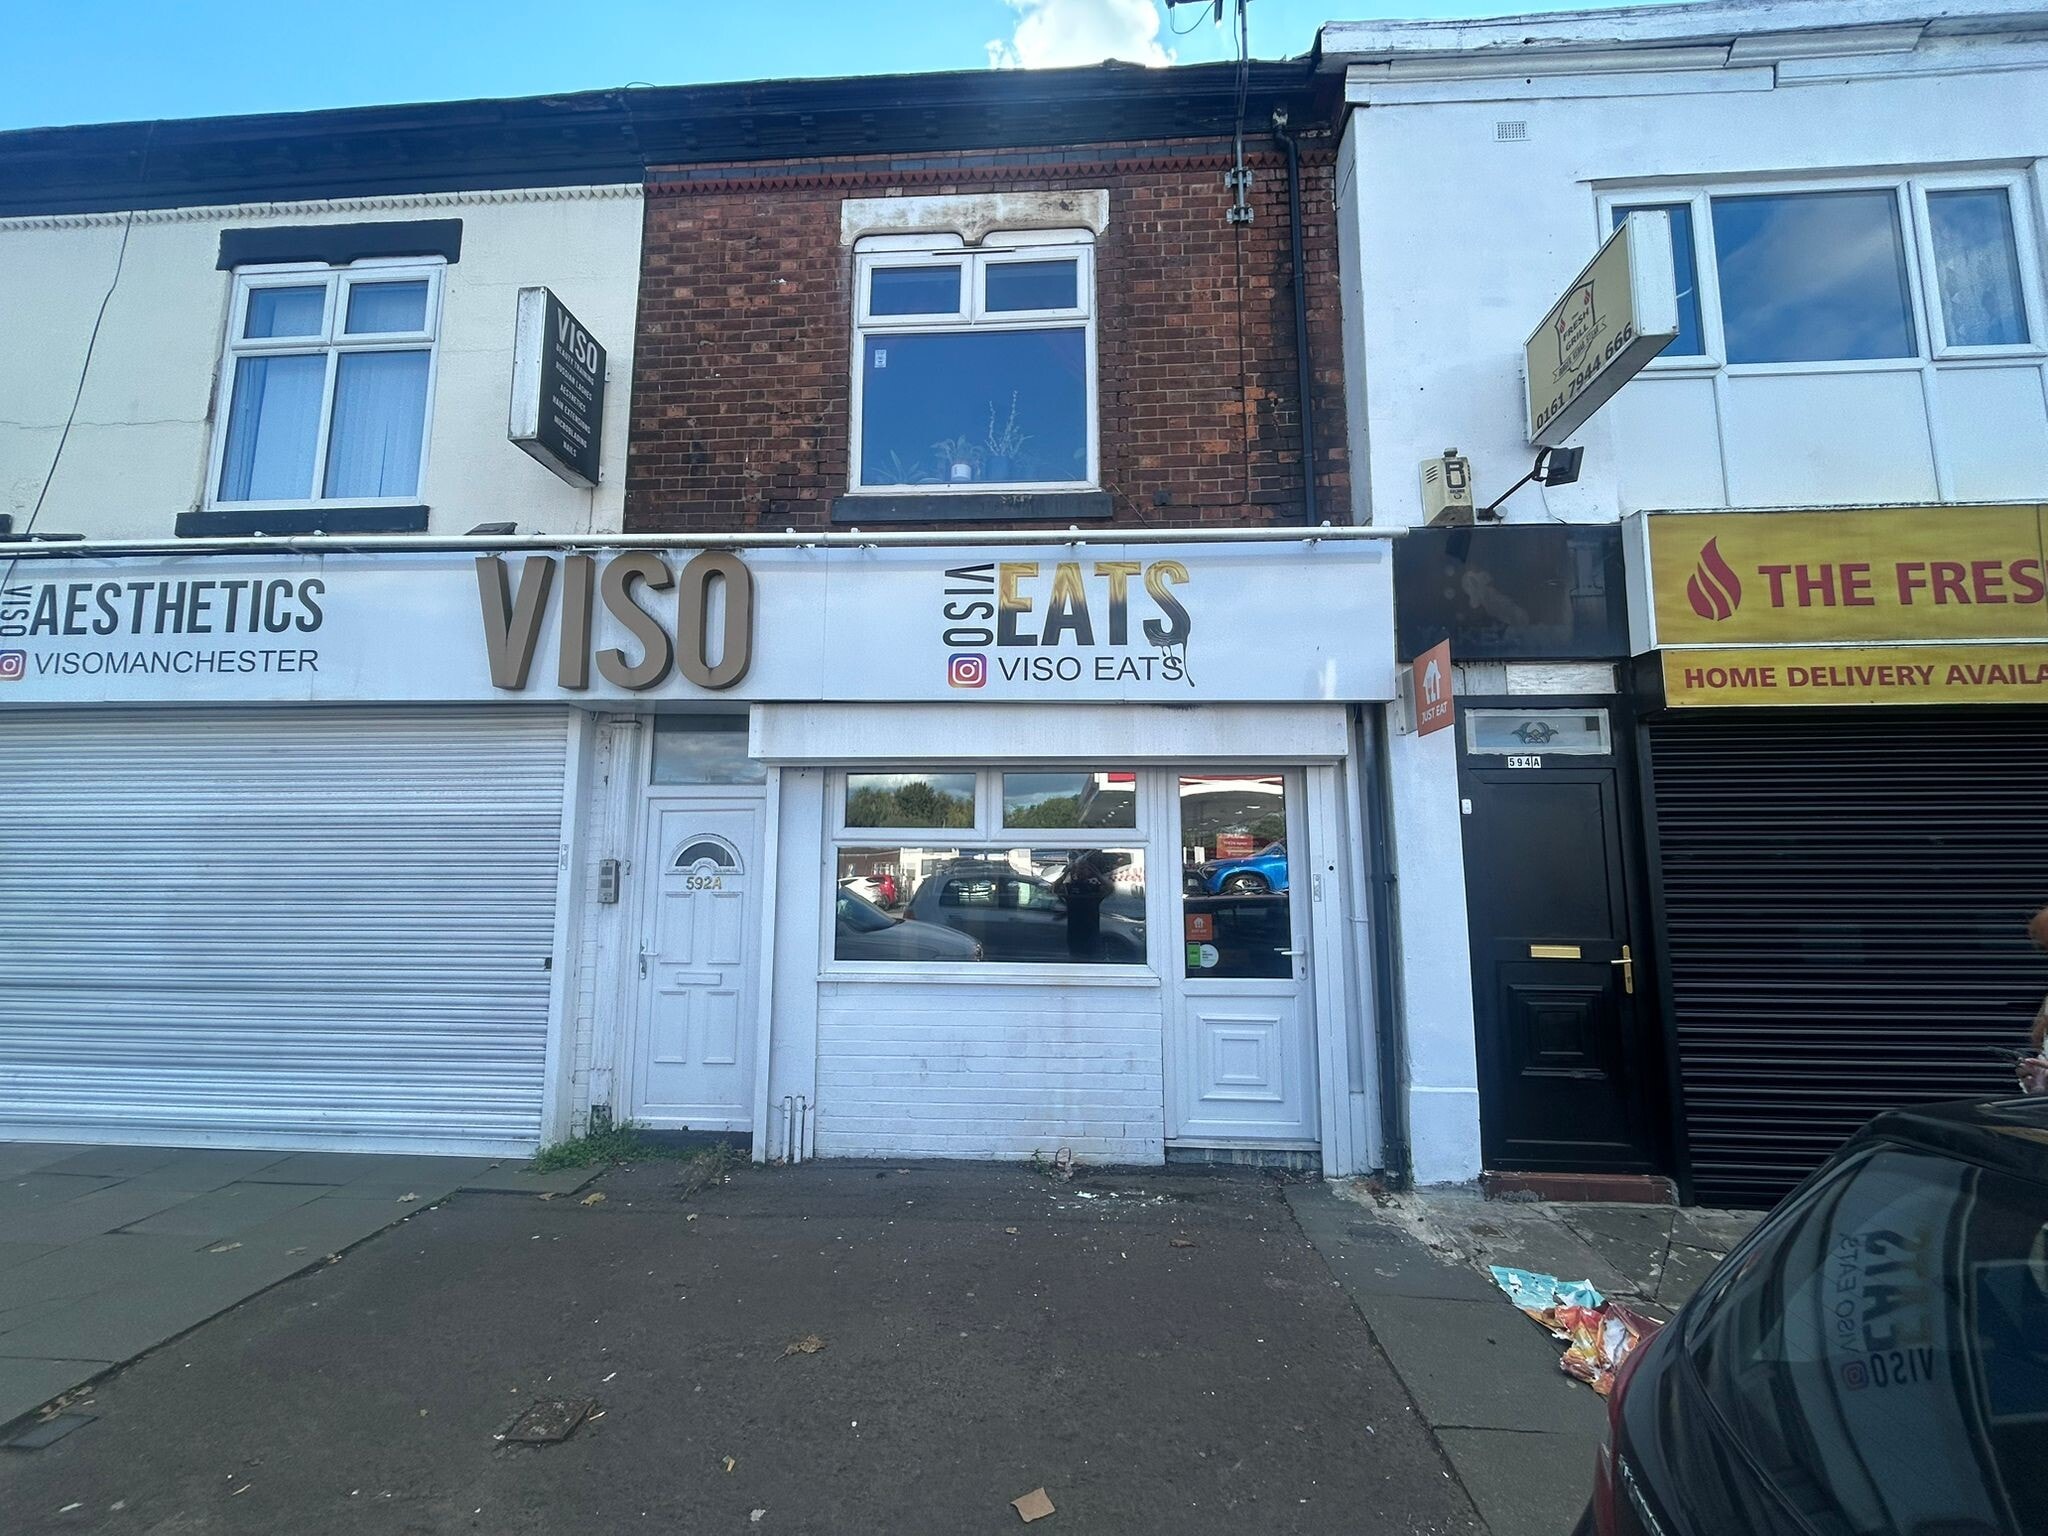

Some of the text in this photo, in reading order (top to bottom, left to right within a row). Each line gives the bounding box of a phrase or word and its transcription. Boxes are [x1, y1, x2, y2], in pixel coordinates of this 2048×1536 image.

[557, 307, 598, 374] VISO
[1563, 307, 1590, 341] FRESH
[1565, 324, 1589, 351] GRILL
[1536, 392, 1565, 430] 0161
[1568, 354, 1602, 399] 7944
[1605, 322, 1633, 360] 666
[560, 384, 586, 413] AESTHETICS
[564, 405, 591, 434] EXTENSIONS
[1758, 559, 2048, 608] THE FRES
[0, 585, 33, 637] VISO
[28, 578, 326, 636] AESTHETICS
[475, 550, 753, 690] VISO
[942, 562, 995, 647] VISO
[997, 560, 1192, 650] EATS
[34, 648, 319, 676] VISOMANCHESTER
[998, 654, 1184, 682] VISO EATS
[1684, 666, 1777, 690] HOME
[1786, 664, 1935, 688] DELIVERY
[1421, 700, 1449, 725] JUST EAT
[685, 876, 722, 890] 592A
